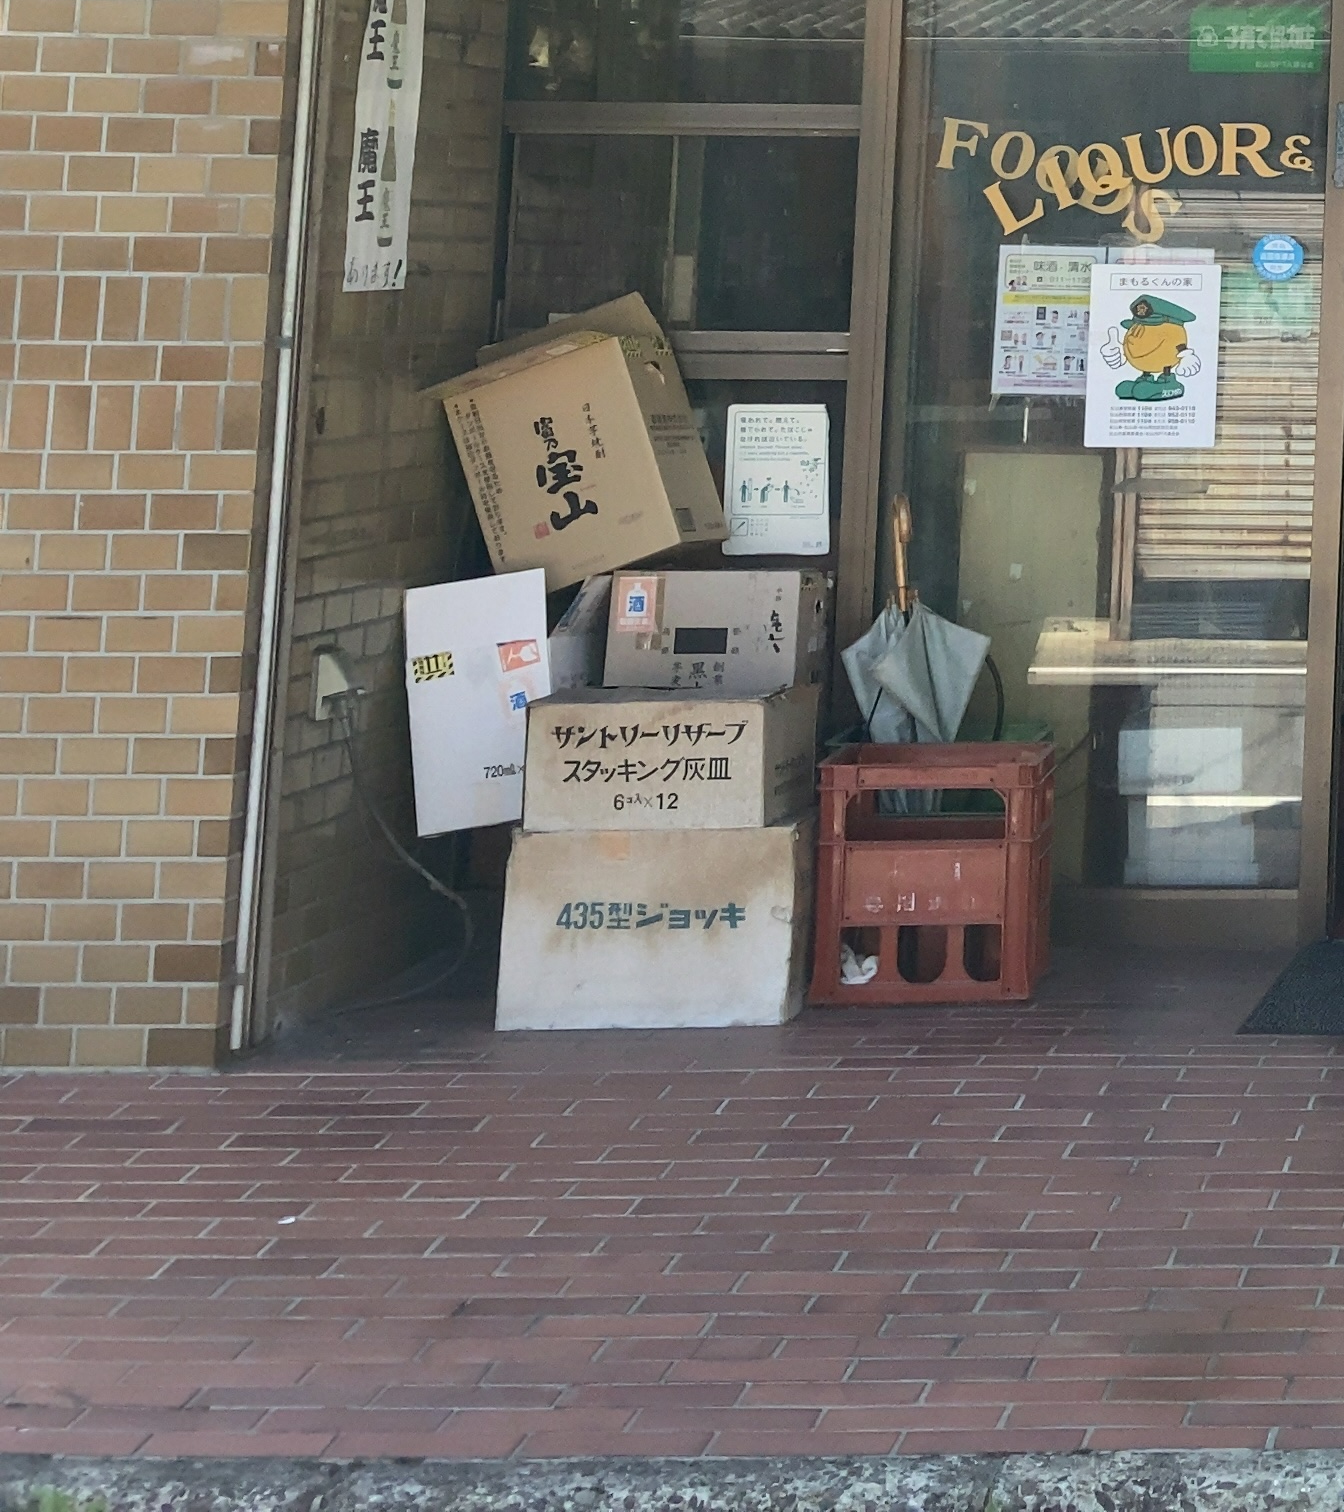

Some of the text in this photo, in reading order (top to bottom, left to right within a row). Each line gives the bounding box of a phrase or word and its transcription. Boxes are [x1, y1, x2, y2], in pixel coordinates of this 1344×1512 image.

[983, 123, 1285, 236] LIQUOR
[1118, 275, 1194, 289] まもるくんの家
[629, 595, 646, 614] 酒
[510, 691, 528, 711] 酒
[551, 719, 749, 749] サントリーリザーブ
[562, 757, 732, 784] スタッキング灰皿
[555, 900, 747, 930] 435型ジョッキ
